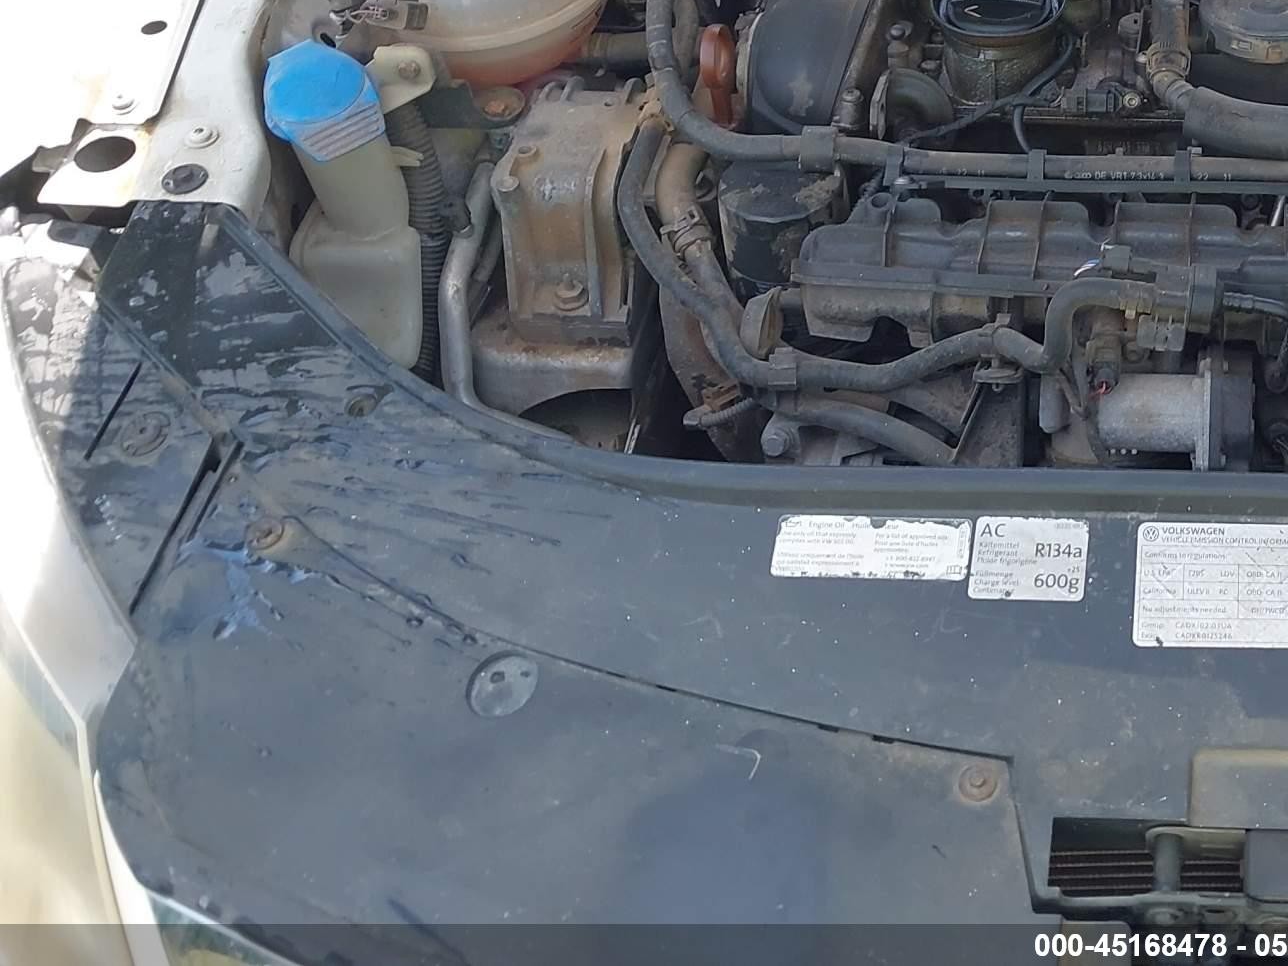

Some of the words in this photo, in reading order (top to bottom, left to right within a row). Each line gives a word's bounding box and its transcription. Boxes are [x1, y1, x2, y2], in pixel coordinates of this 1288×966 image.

[808, 521, 833, 529] Engine
[980, 523, 1006, 538] AC
[1162, 526, 1225, 536] VOLKSWAGEN
[1225, 537, 1258, 545] CONTROL
[1034, 542, 1082, 558] R134a
[1033, 573, 1079, 594] 600g
